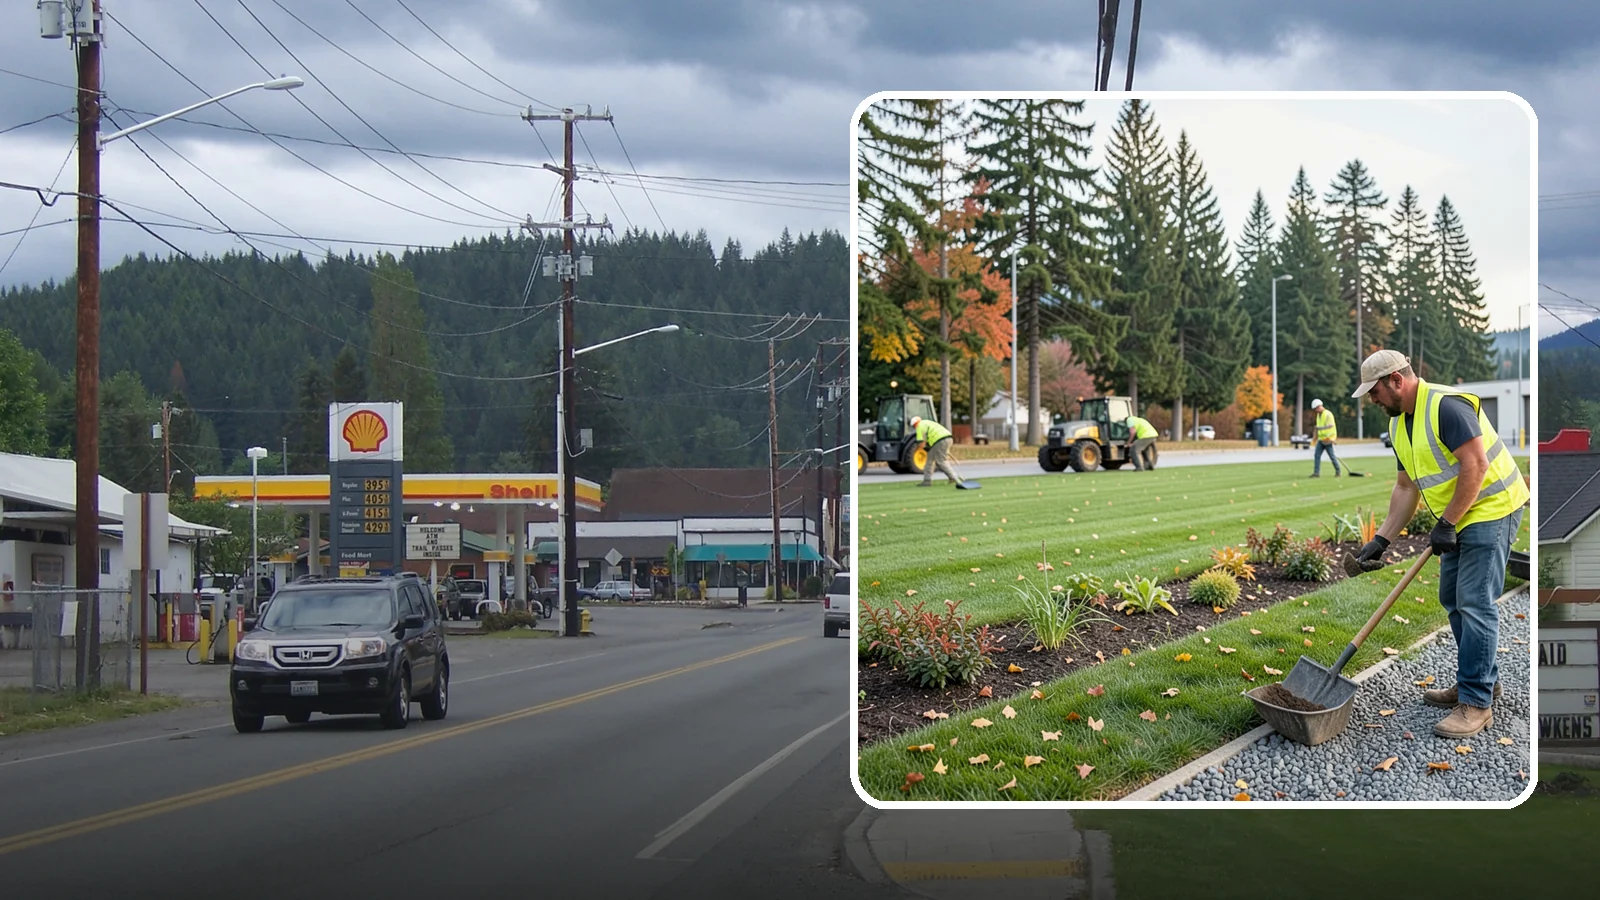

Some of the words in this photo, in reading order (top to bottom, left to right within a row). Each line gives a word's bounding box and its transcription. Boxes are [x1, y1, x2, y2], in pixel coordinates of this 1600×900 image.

[366, 480, 383, 490] 395
[490, 484, 547, 499] Shell
[366, 494, 383, 504] 405
[366, 508, 383, 518] 415
[366, 522, 383, 532] 429
[1538, 642, 1567, 665] AID
